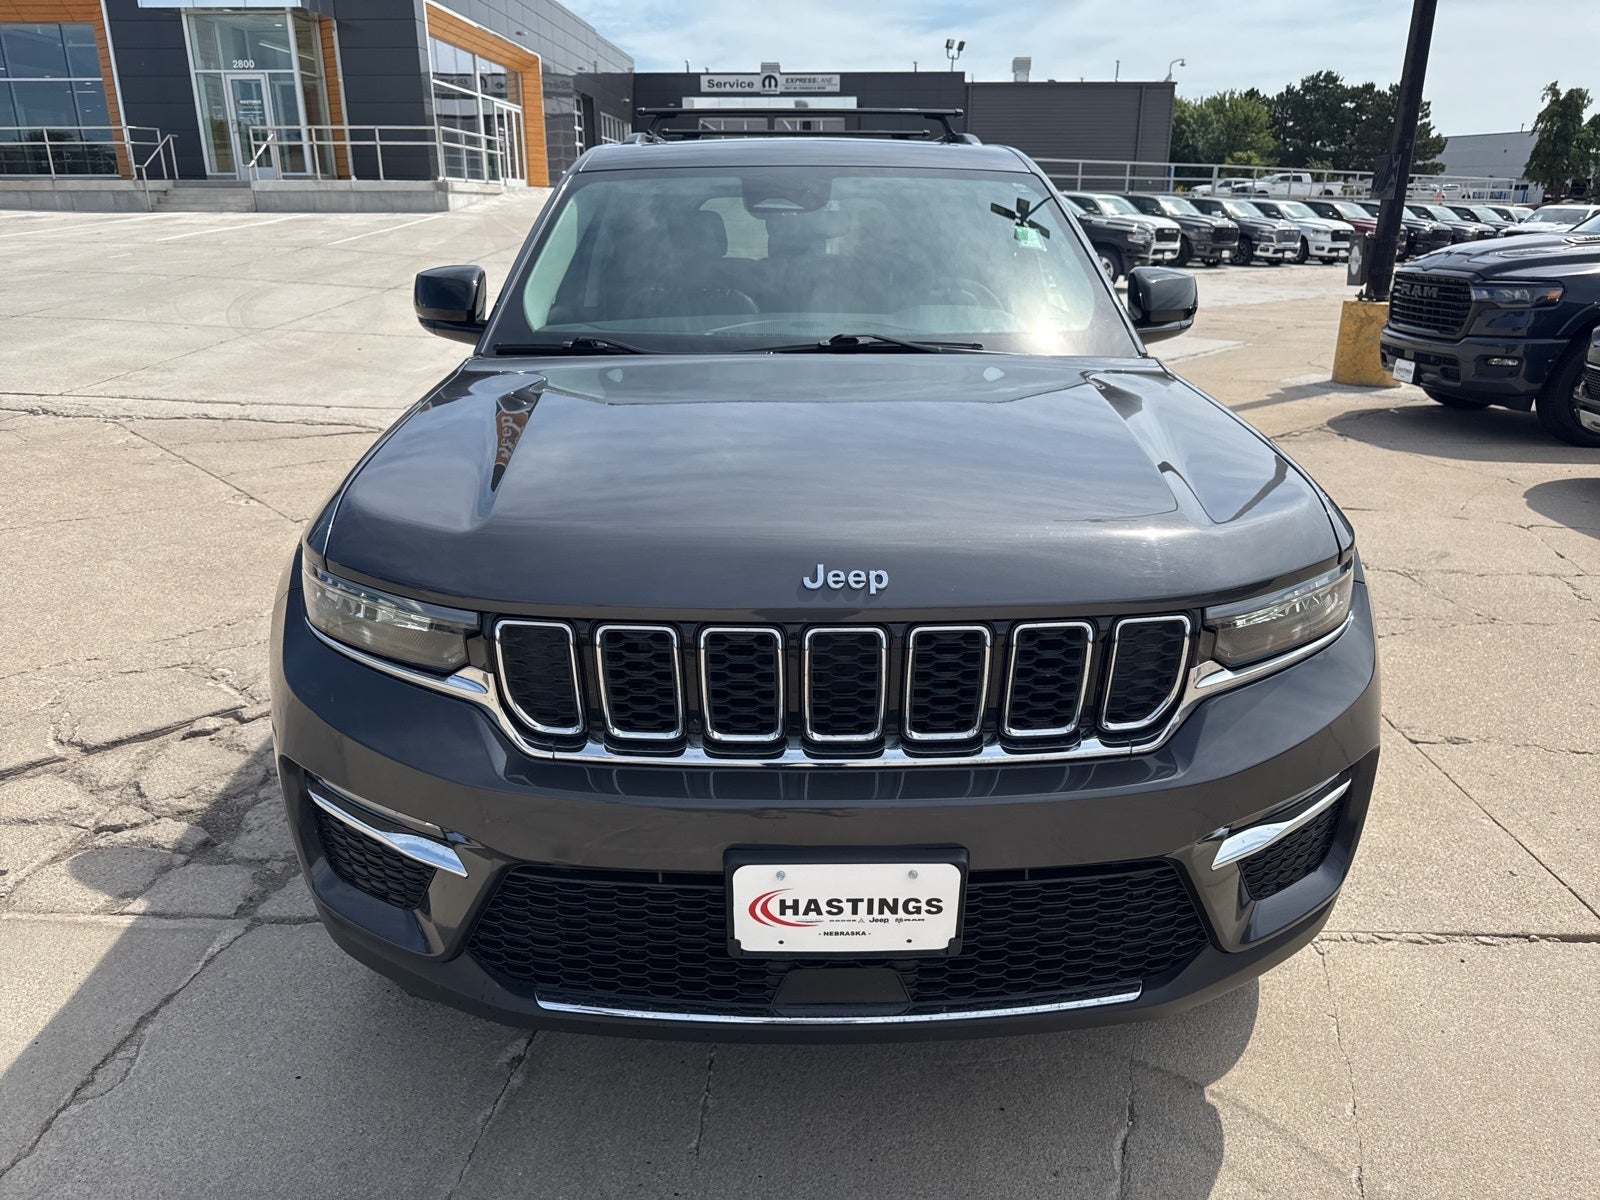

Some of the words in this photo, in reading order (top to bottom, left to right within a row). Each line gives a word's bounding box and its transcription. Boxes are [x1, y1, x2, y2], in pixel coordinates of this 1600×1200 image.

[232, 60, 255, 69] 2800
[707, 79, 754, 89] Service
[1401, 283, 1439, 298] RAM
[802, 563, 889, 595] Jeep
[778, 897, 944, 917] HASTINGS
